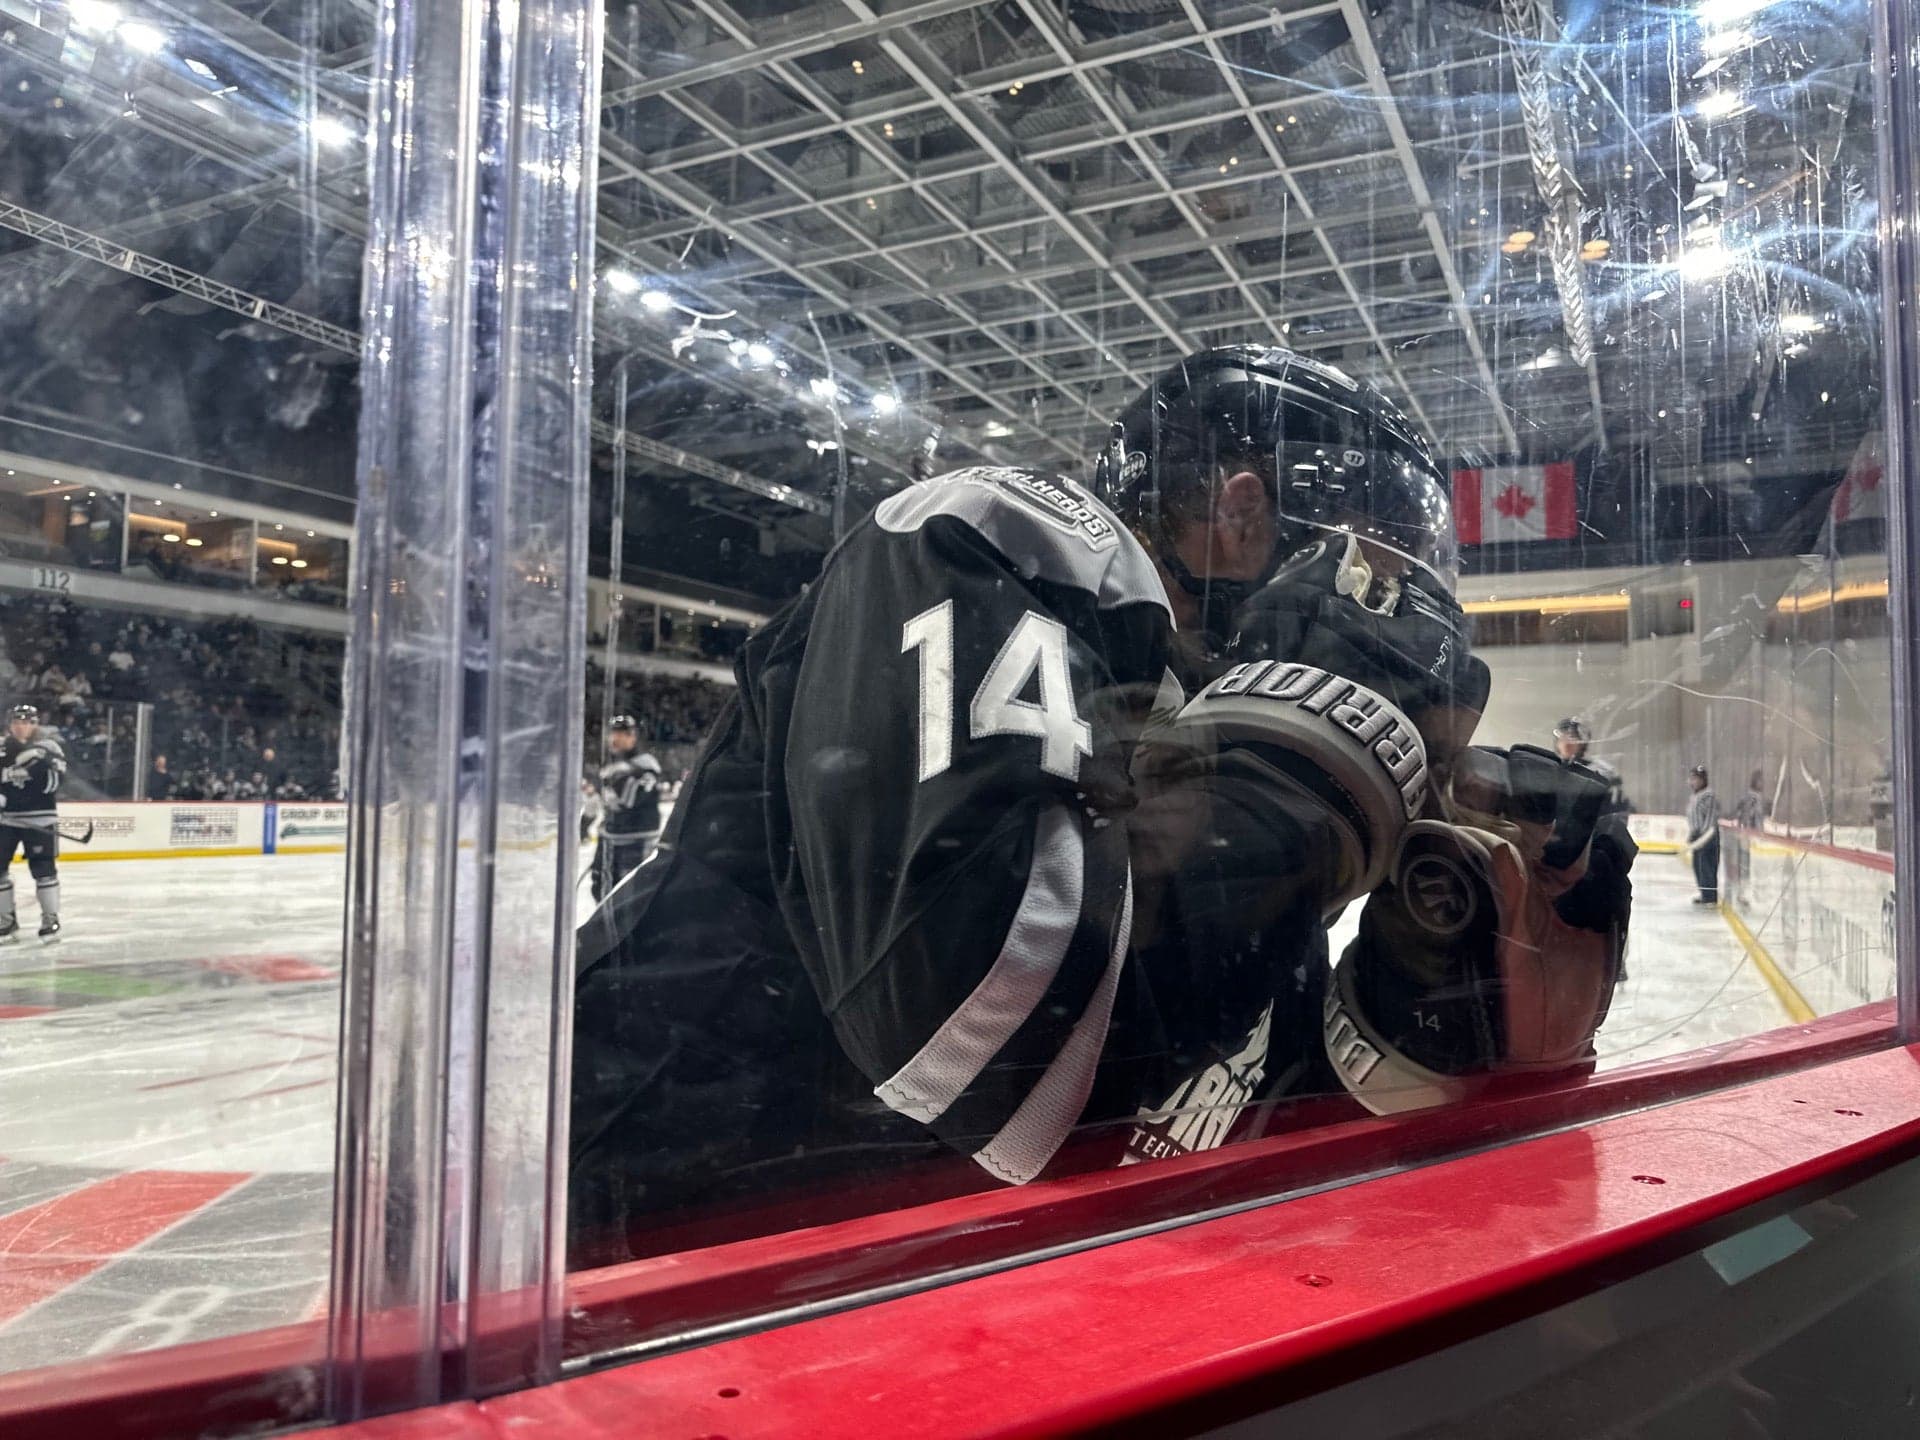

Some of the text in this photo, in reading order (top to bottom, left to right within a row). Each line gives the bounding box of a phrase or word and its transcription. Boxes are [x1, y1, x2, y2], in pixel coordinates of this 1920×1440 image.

[39, 567, 70, 590] 112
[901, 598, 1094, 784] 14
[1205, 659, 1427, 820] ARRIOR
[1412, 1010, 1442, 1032] 14
